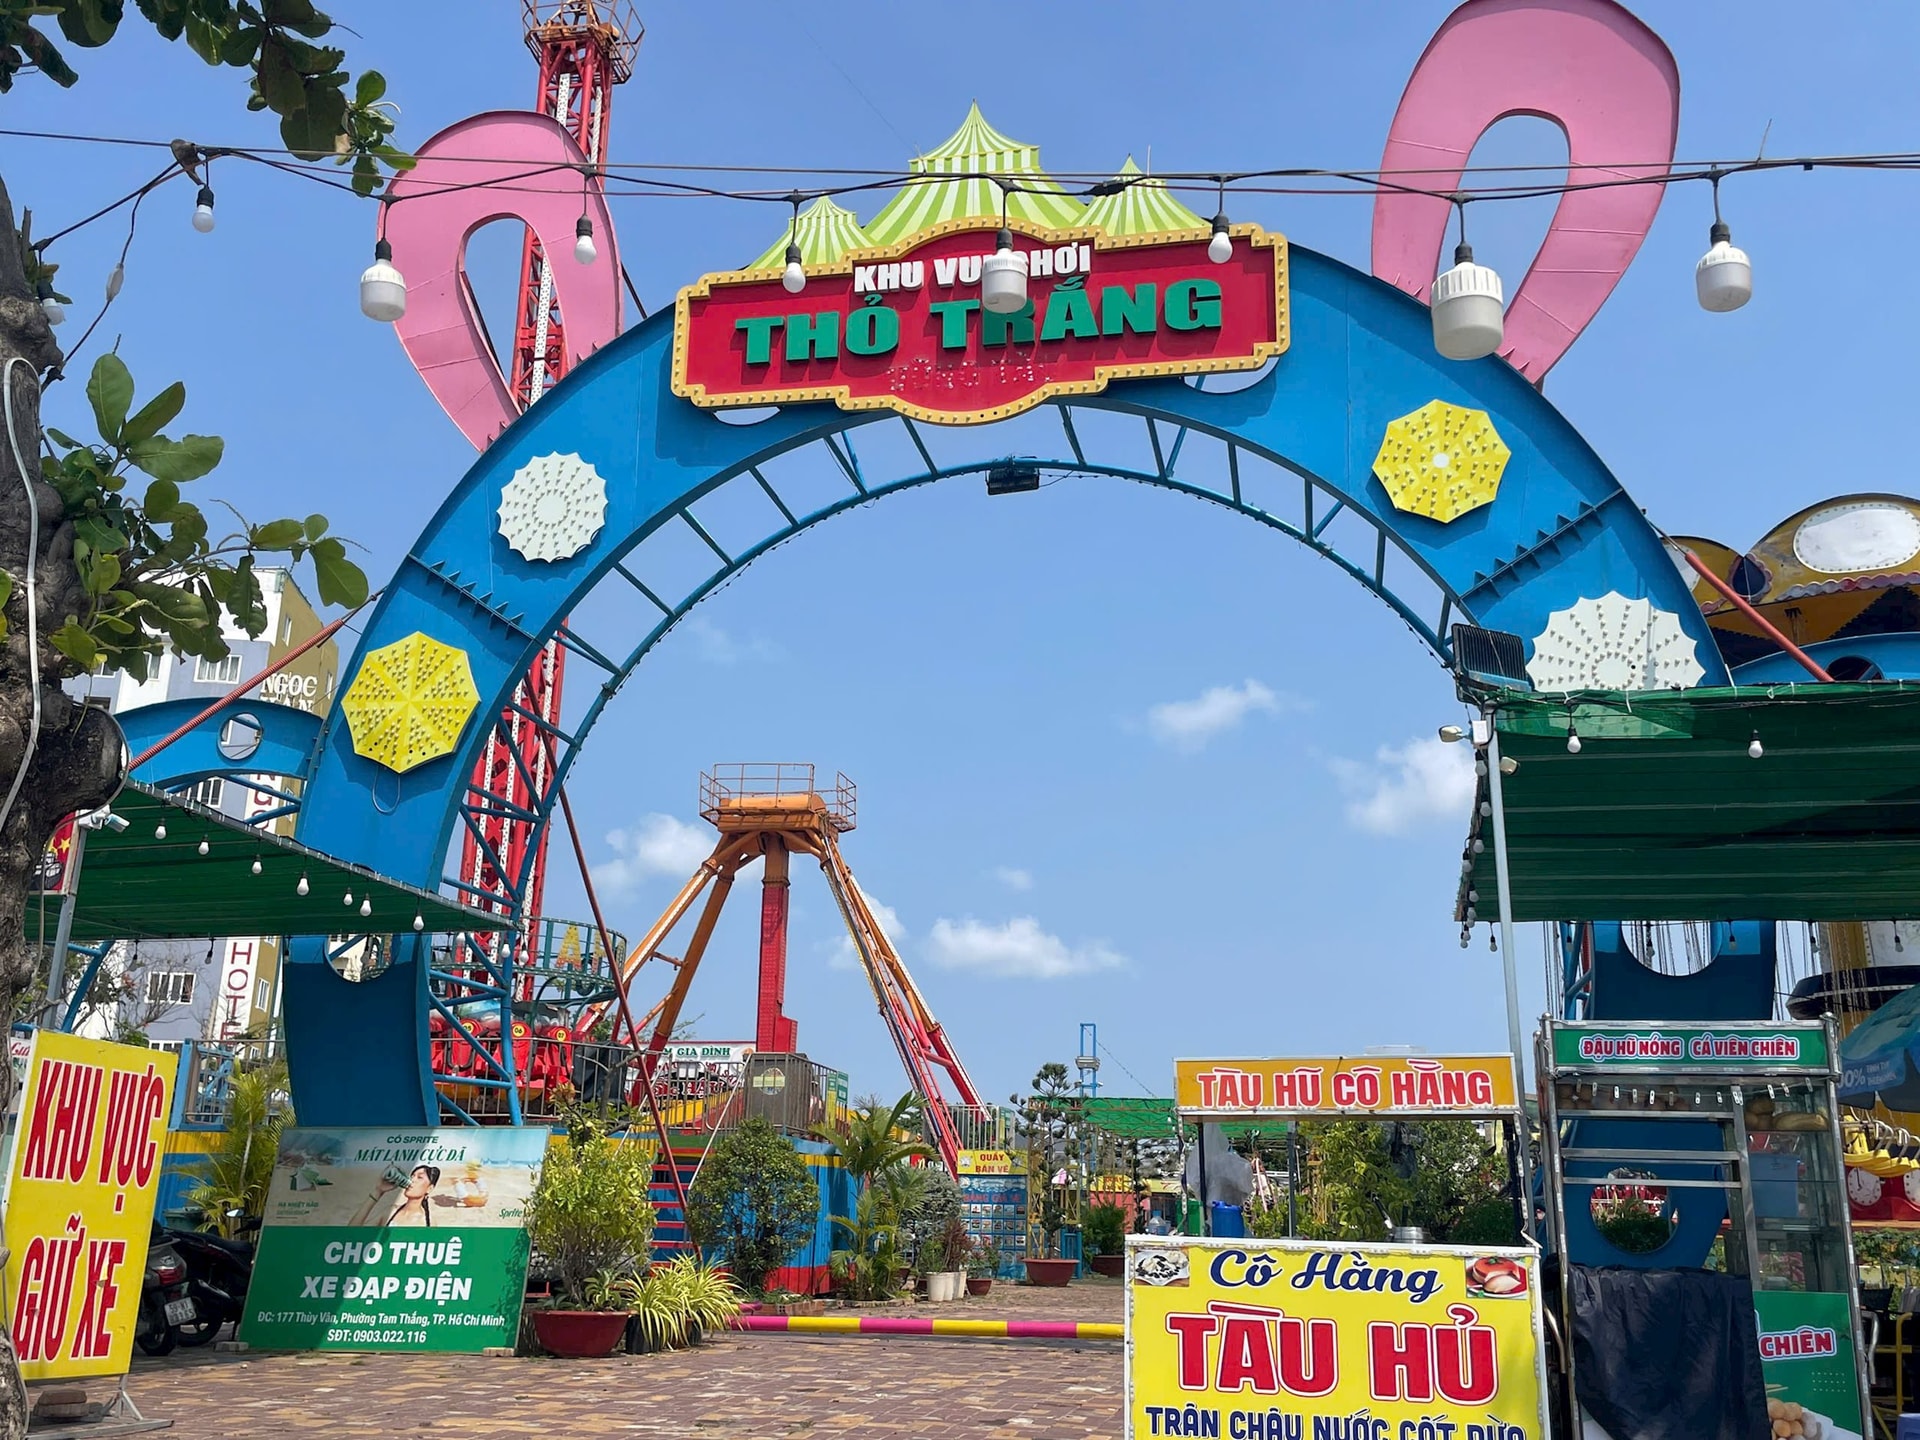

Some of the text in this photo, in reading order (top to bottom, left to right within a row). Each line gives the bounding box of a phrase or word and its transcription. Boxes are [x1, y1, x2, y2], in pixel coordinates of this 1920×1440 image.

[854, 242, 1091, 293] KHU VU HƠI
[735, 274, 1224, 364] THỎ TRẮNG
[677, 1047, 698, 1056] GIA
[702, 1045, 731, 1056] ĐÌNH
[1582, 1037, 1613, 1059] ĐẬU
[1639, 1036, 1681, 1056] NÓNG
[1691, 1036, 1712, 1056] CÁ
[1713, 1037, 1749, 1056] VIÊN
[1749, 1037, 1795, 1056] CHIÊN
[1197, 1060, 1493, 1107] TÀU HŨ CÔ HẰNG
[22, 1059, 166, 1213] KHU VỰC
[386, 1133, 439, 1144] CÓ SPRITE
[354, 1146, 385, 1162] MÁT
[324, 1236, 463, 1266] CHO THUÊ
[13, 1213, 127, 1361] GIỮ XE
[300, 1271, 473, 1306] XE ĐẠP ĐIỆN
[1209, 1250, 1445, 1303] Cô Hằng
[257, 1311, 275, 1323] ĐC:
[277, 1311, 294, 1323] 177
[340, 1312, 377, 1326] Phường
[378, 1313, 397, 1324] Tam
[399, 1311, 431, 1327] Thắng,
[432, 1313, 447, 1325] TP.
[463, 1313, 481, 1326] Chí
[480, 1314, 505, 1327] Minh
[327, 1328, 428, 1343] SĐT: 0903.022.116
[1166, 1301, 1500, 1406] TÀU HỦ
[1759, 1329, 1834, 1358] CHIÊN
[1145, 1402, 1221, 1439] TRÂN
[1229, 1407, 1302, 1440] CHÂU
[1313, 1407, 1390, 1440] NƯỚC
